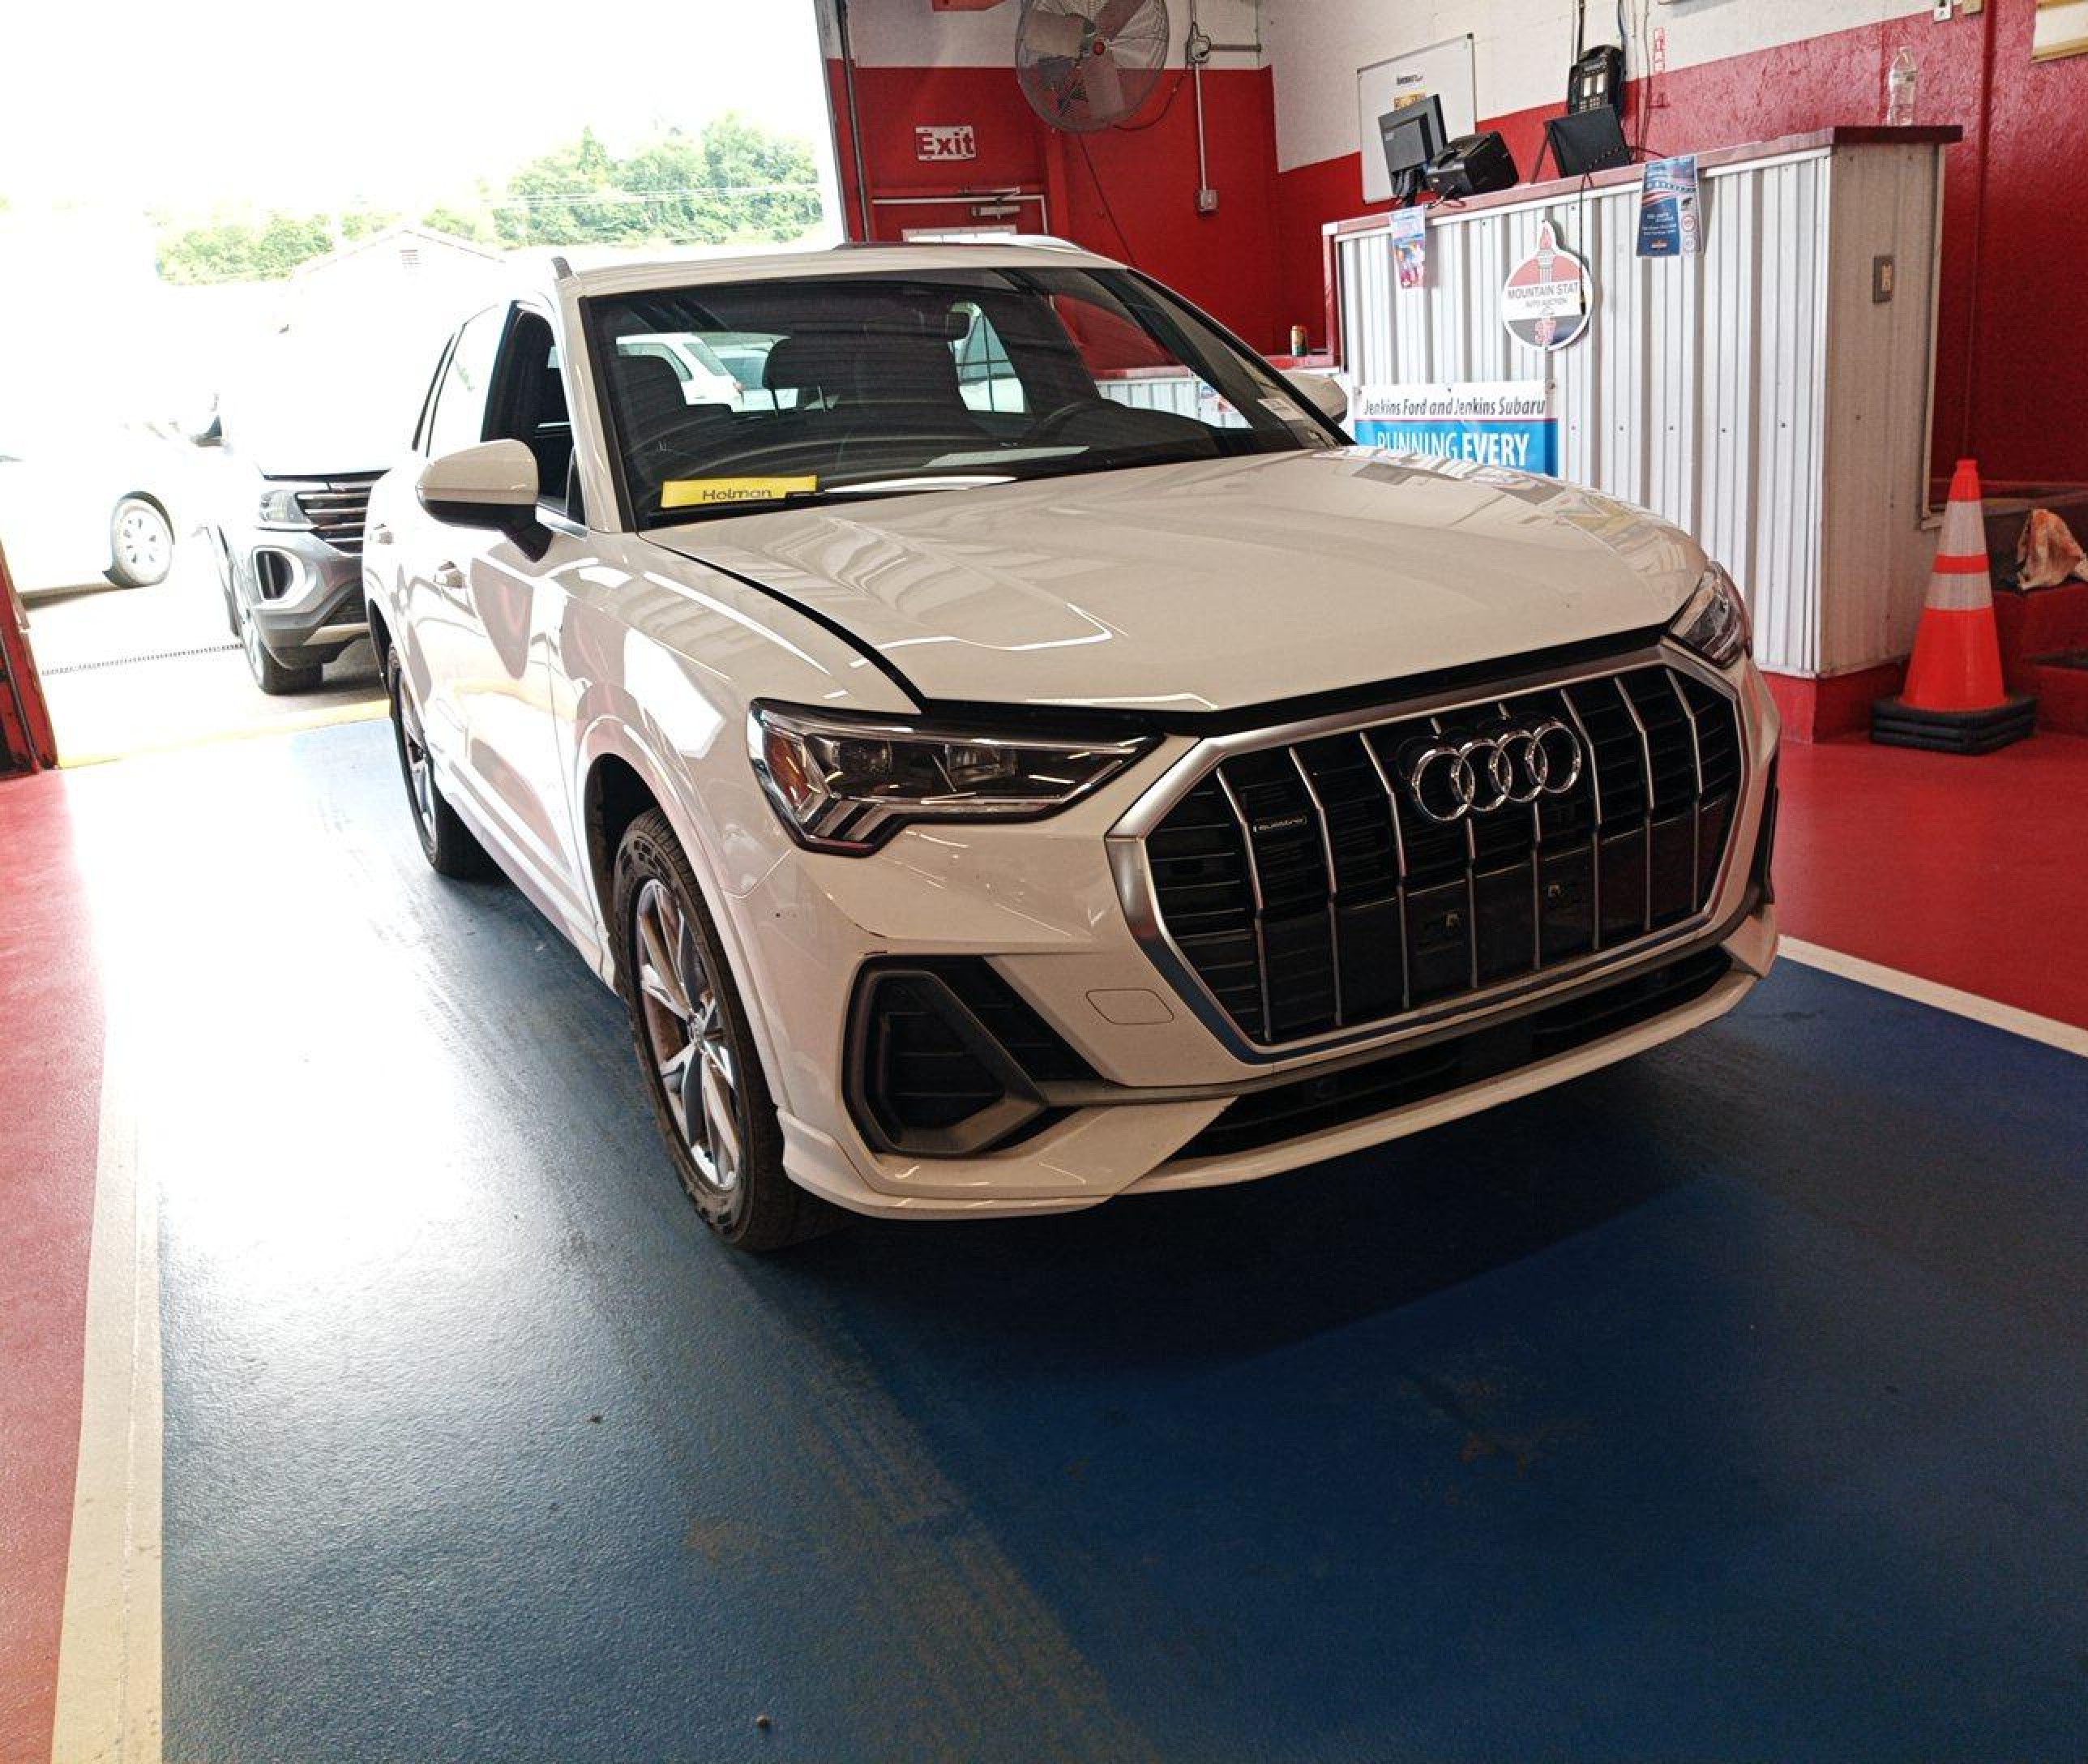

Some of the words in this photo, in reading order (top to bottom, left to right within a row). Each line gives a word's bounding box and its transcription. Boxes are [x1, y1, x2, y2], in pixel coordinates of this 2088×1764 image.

[916, 132, 974, 155] Exit
[1508, 285, 1554, 299] MOUNTAIN
[1556, 281, 1583, 295] STAT
[1364, 397, 1401, 416] Jenkins
[1402, 398, 1427, 415] Ford
[1429, 397, 1453, 415] and
[1455, 397, 1495, 415] Jenkins
[1499, 396, 1546, 415] Subaru
[1461, 432, 1530, 466] EVERY
[702, 489, 772, 500] Holman
